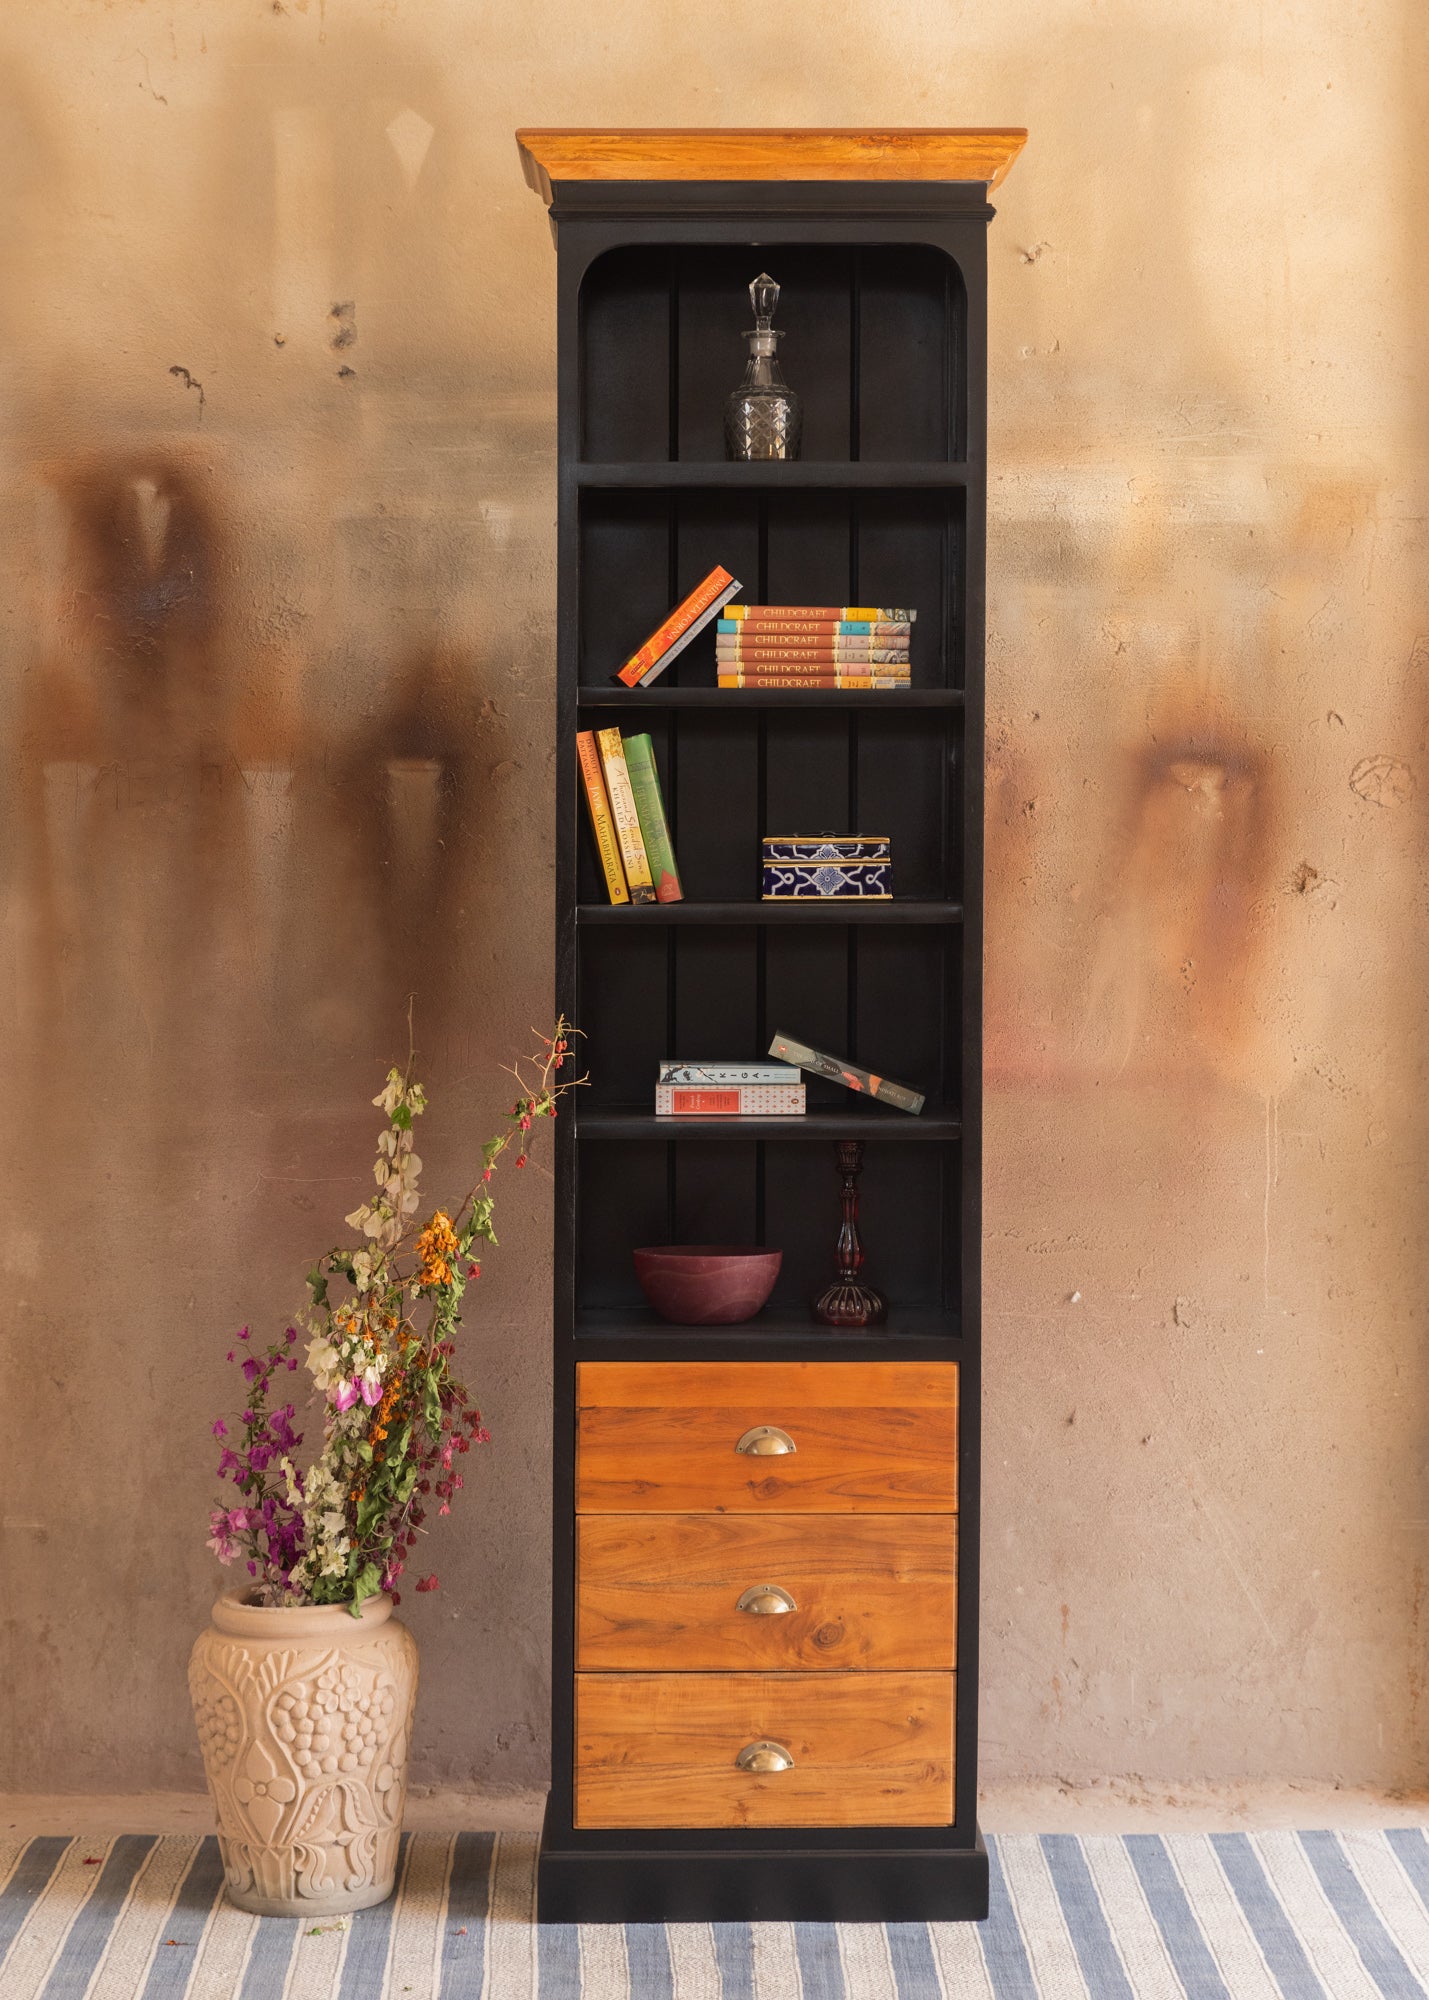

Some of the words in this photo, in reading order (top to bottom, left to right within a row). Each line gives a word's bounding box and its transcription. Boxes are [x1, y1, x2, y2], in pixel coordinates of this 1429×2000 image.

[690, 576, 727, 617] AMINATTA
[763, 608, 828, 617] CHILDCRAFT
[666, 613, 693, 641] FORNA
[756, 622, 821, 631] CHILDCRAFT
[755, 635, 820, 644] CHILDCRAFT
[754, 650, 819, 659] CHILDCRAFT
[756, 664, 821, 674] CHILDCRAFT
[757, 678, 822, 688] CHILDCRAFT
[579, 740, 593, 782] PATTANAIK
[586, 738, 599, 775] DEVDUTT
[615, 767, 625, 777] A
[612, 787, 624, 823] KHALED
[620, 826, 634, 869] HOSSEINI
[589, 785, 602, 811] JAYA
[597, 813, 617, 884] MAHABHARATA
